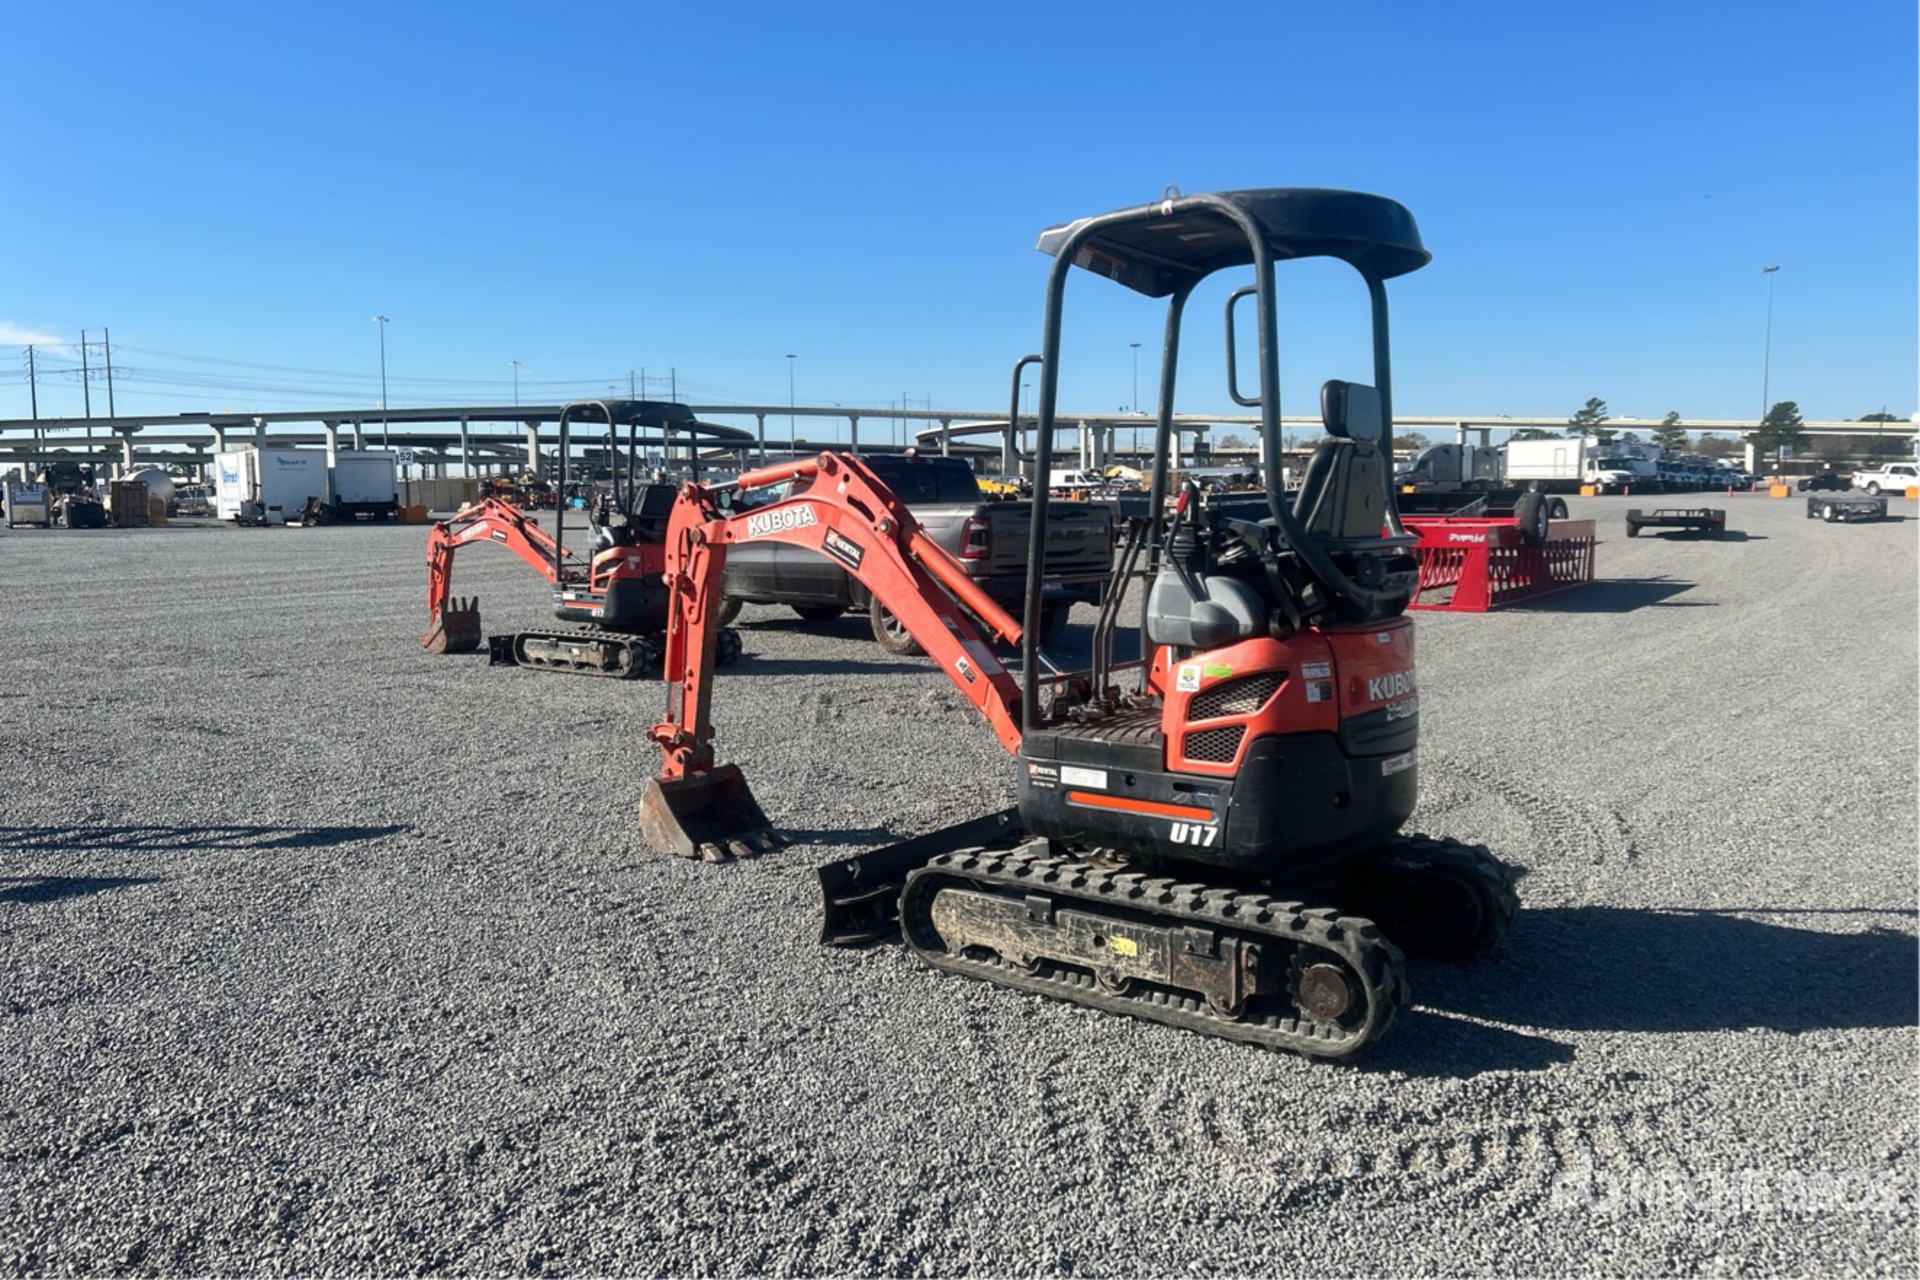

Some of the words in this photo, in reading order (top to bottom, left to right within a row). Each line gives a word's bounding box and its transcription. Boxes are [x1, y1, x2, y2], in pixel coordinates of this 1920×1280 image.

[400, 452, 412, 461] 52
[748, 504, 816, 537] KUBOTA
[1170, 822, 1219, 847] U17
